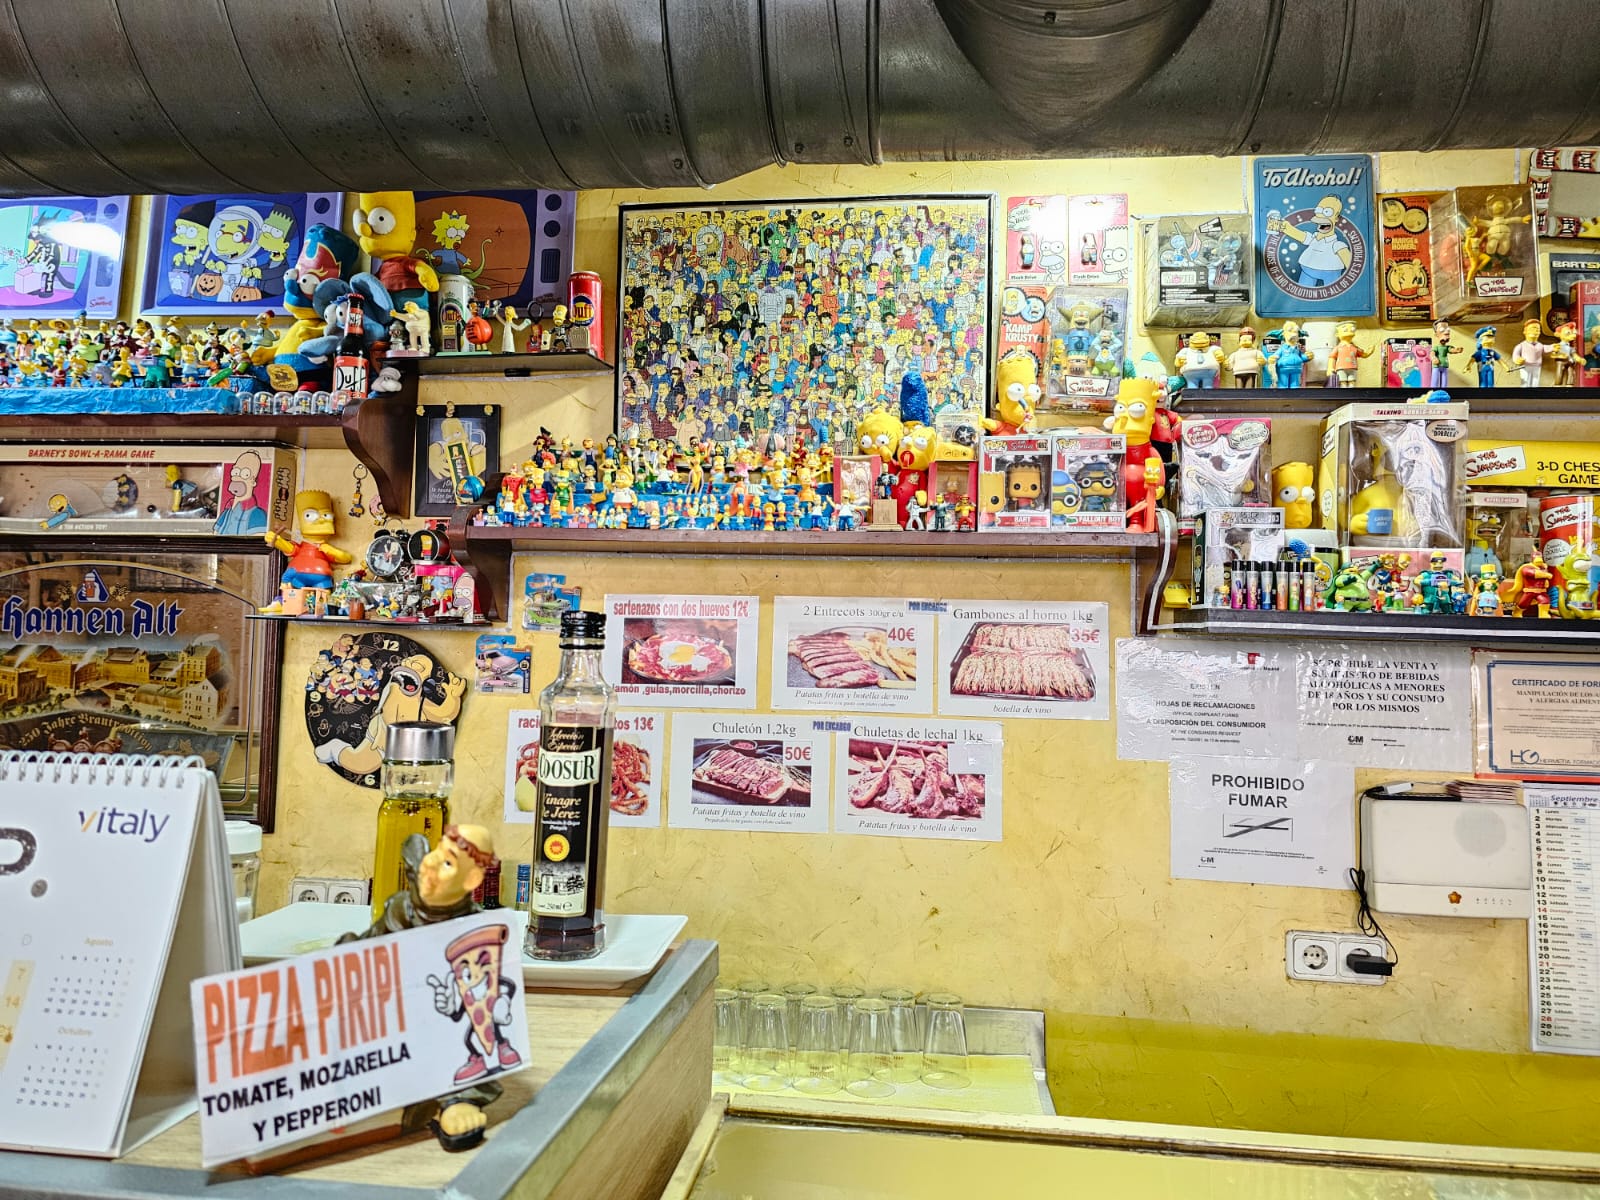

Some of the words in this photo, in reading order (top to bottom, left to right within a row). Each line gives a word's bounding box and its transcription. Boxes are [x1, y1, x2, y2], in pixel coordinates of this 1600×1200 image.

[1263, 168, 1289, 187] To
[1284, 168, 1362, 187] Alcohol!
[1286, 284, 1318, 298] SOLUTION
[1006, 323, 1033, 334] KAMP
[1005, 332, 1039, 343] KRUSTY
[336, 366, 367, 392] Duff
[28, 449, 66, 458] BARNEY'S
[68, 450, 128, 459] BOWL-A-RAMA
[130, 450, 156, 459] GAME
[1537, 461, 1559, 471] 3-D
[1558, 473, 1600, 485] GAME
[613, 600, 661, 616] sartenazos
[663, 603, 679, 616] con
[681, 600, 697, 617] dos
[700, 600, 730, 617] huevos
[733, 600, 750, 617] 12€
[803, 605, 810, 616] 2
[814, 606, 865, 617] Entrecots
[131, 598, 185, 639] Alt
[953, 608, 1015, 620] Gambones
[1018, 609, 1029, 620] al
[1033, 609, 1067, 620] horno
[1072, 610, 1094, 623] 1kg
[888, 627, 916, 642] 40€
[1071, 629, 1100, 643] 35€
[383, 640, 400, 651] 12
[1393, 662, 1428, 670] VENTA
[1430, 662, 1439, 670] Y
[1379, 672, 1394, 680] DE
[1395, 673, 1440, 681] BEBIDAS
[1512, 679, 1567, 687] CERTIFICADO
[1384, 682, 1392, 690] A
[1393, 684, 1446, 692] MENORES
[310, 691, 321, 702] 9
[1338, 690, 1365, 700] AÑOS
[1391, 694, 1446, 703] CONSUMO
[993, 704, 1021, 714] botella
[1022, 705, 1033, 714] de
[1193, 702, 1256, 710] RECLAMACIONES
[1332, 703, 1353, 711] POR
[1356, 703, 1376, 711] LOS
[1378, 704, 1420, 713] MISMOS
[518, 715, 540, 729] raci
[634, 717, 654, 730] 13€
[712, 720, 763, 735] Chuletón
[766, 721, 797, 738] 1,2kg
[813, 720, 824, 730] POR
[1153, 718, 1199, 727] DISPOSICIÓN
[854, 725, 904, 738] Chuletas
[906, 727, 921, 739] de
[924, 728, 958, 740] lechal
[962, 728, 984, 741] 1kg
[784, 746, 811, 761] 50€
[364, 774, 376, 786] 6
[1211, 774, 1305, 792] PROHIBIDO
[1228, 793, 1288, 808] FUMAR
[550, 806, 581, 819] Jerez
[692, 806, 720, 816] Patatas
[721, 807, 742, 818] fritas
[750, 808, 777, 818] botella
[777, 810, 788, 818] de
[789, 811, 806, 819] vino
[78, 806, 171, 843] vitaly
[859, 819, 888, 829] Patatas
[919, 820, 947, 832] botella
[948, 821, 959, 832] de
[960, 824, 977, 833] vino
[202, 965, 309, 1085] PIZZA
[312, 942, 408, 1056] PIRIPI
[202, 1076, 295, 1118] TOMATE,
[299, 1042, 412, 1090] MOZARELLA
[252, 1121, 268, 1143] Y
[273, 1086, 383, 1140] PEPPERONI
